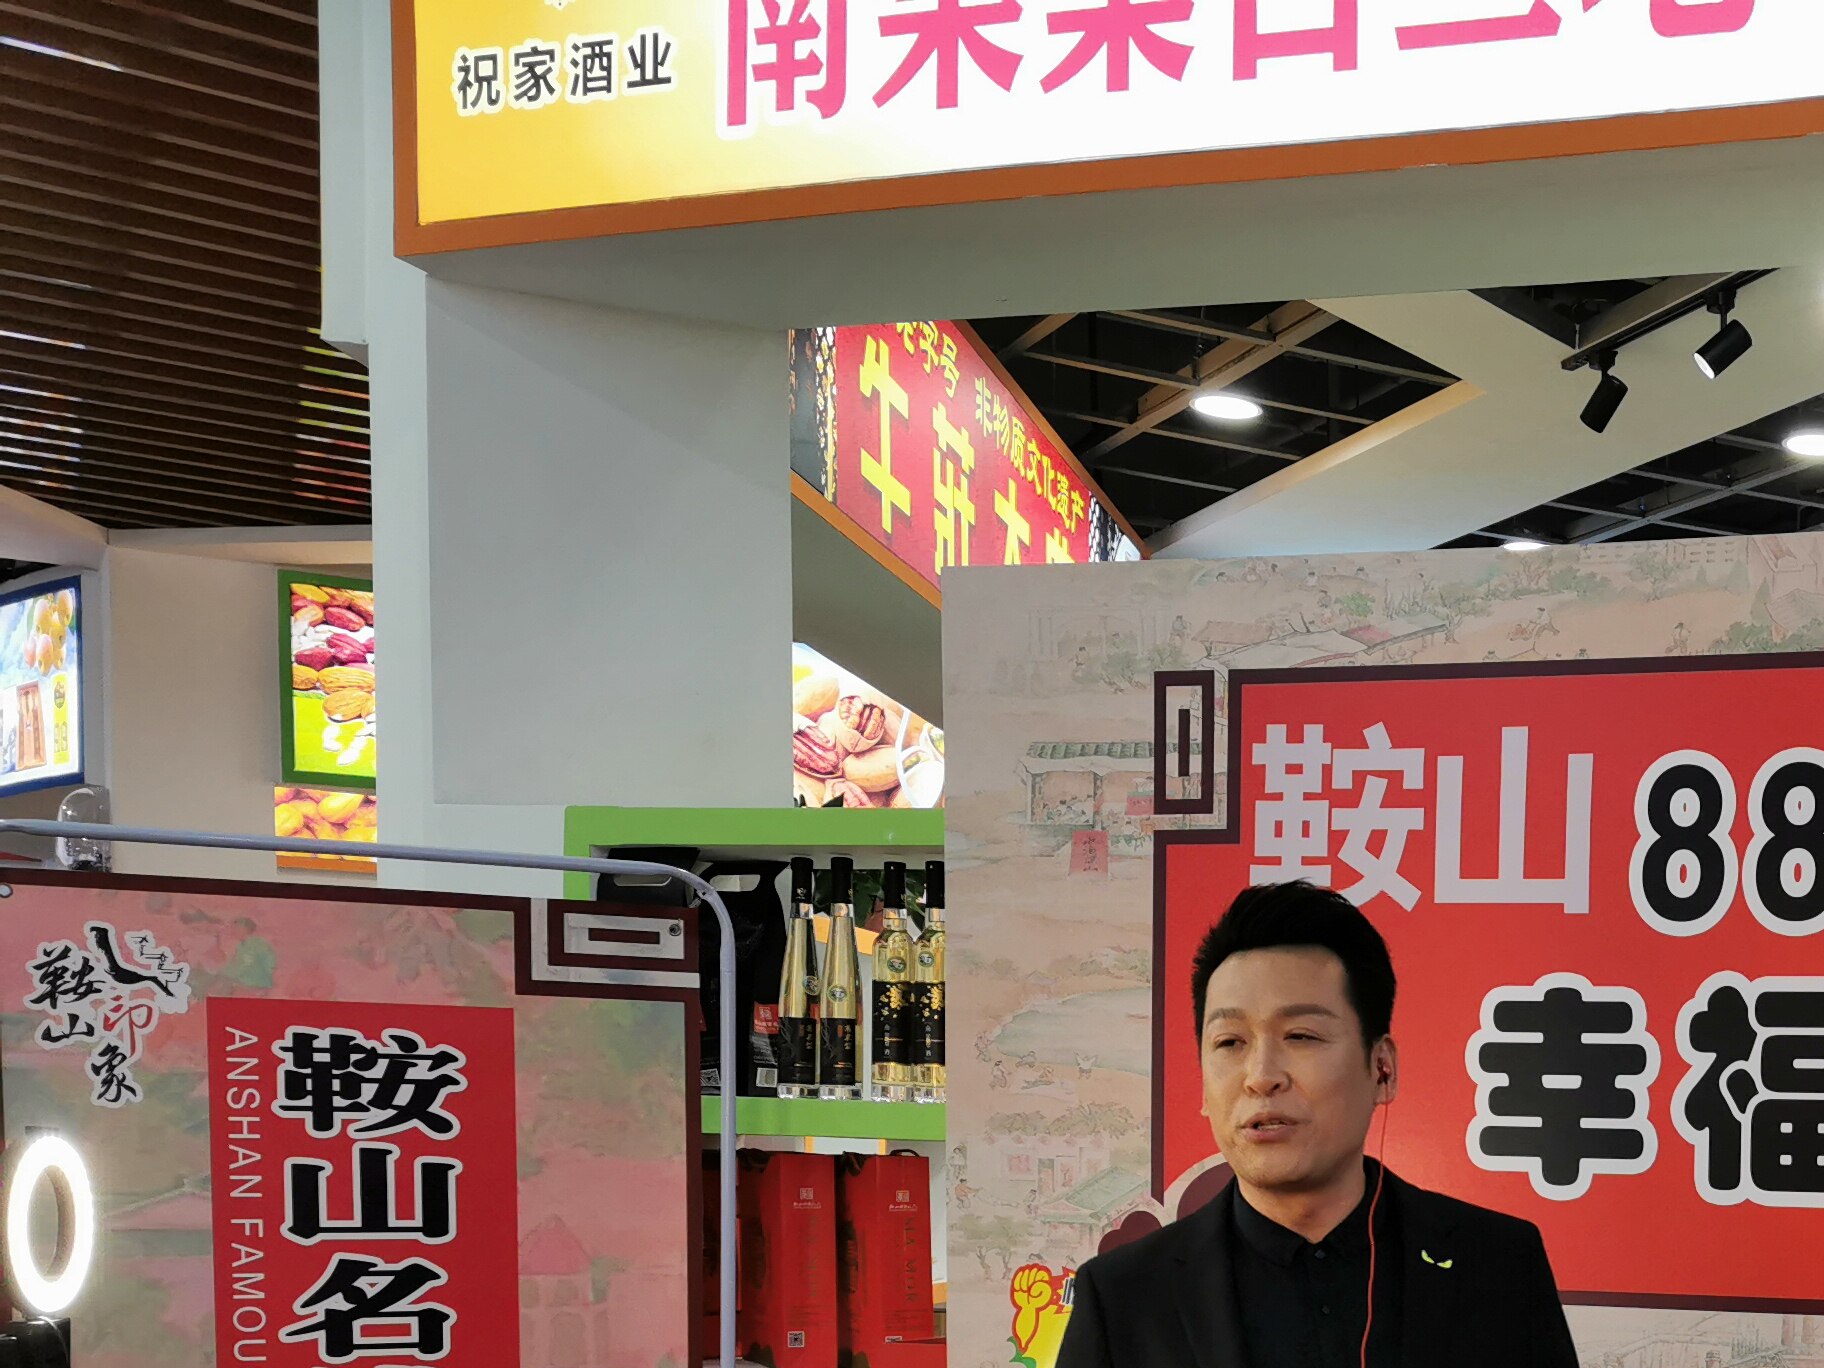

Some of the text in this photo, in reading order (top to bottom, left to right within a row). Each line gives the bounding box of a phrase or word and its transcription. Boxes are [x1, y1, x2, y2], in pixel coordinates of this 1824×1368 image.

[456, 32, 673, 111] 祝家酒业
[1249, 721, 1593, 915] 鞍山
[223, 1026, 264, 1199] ANSHAN
